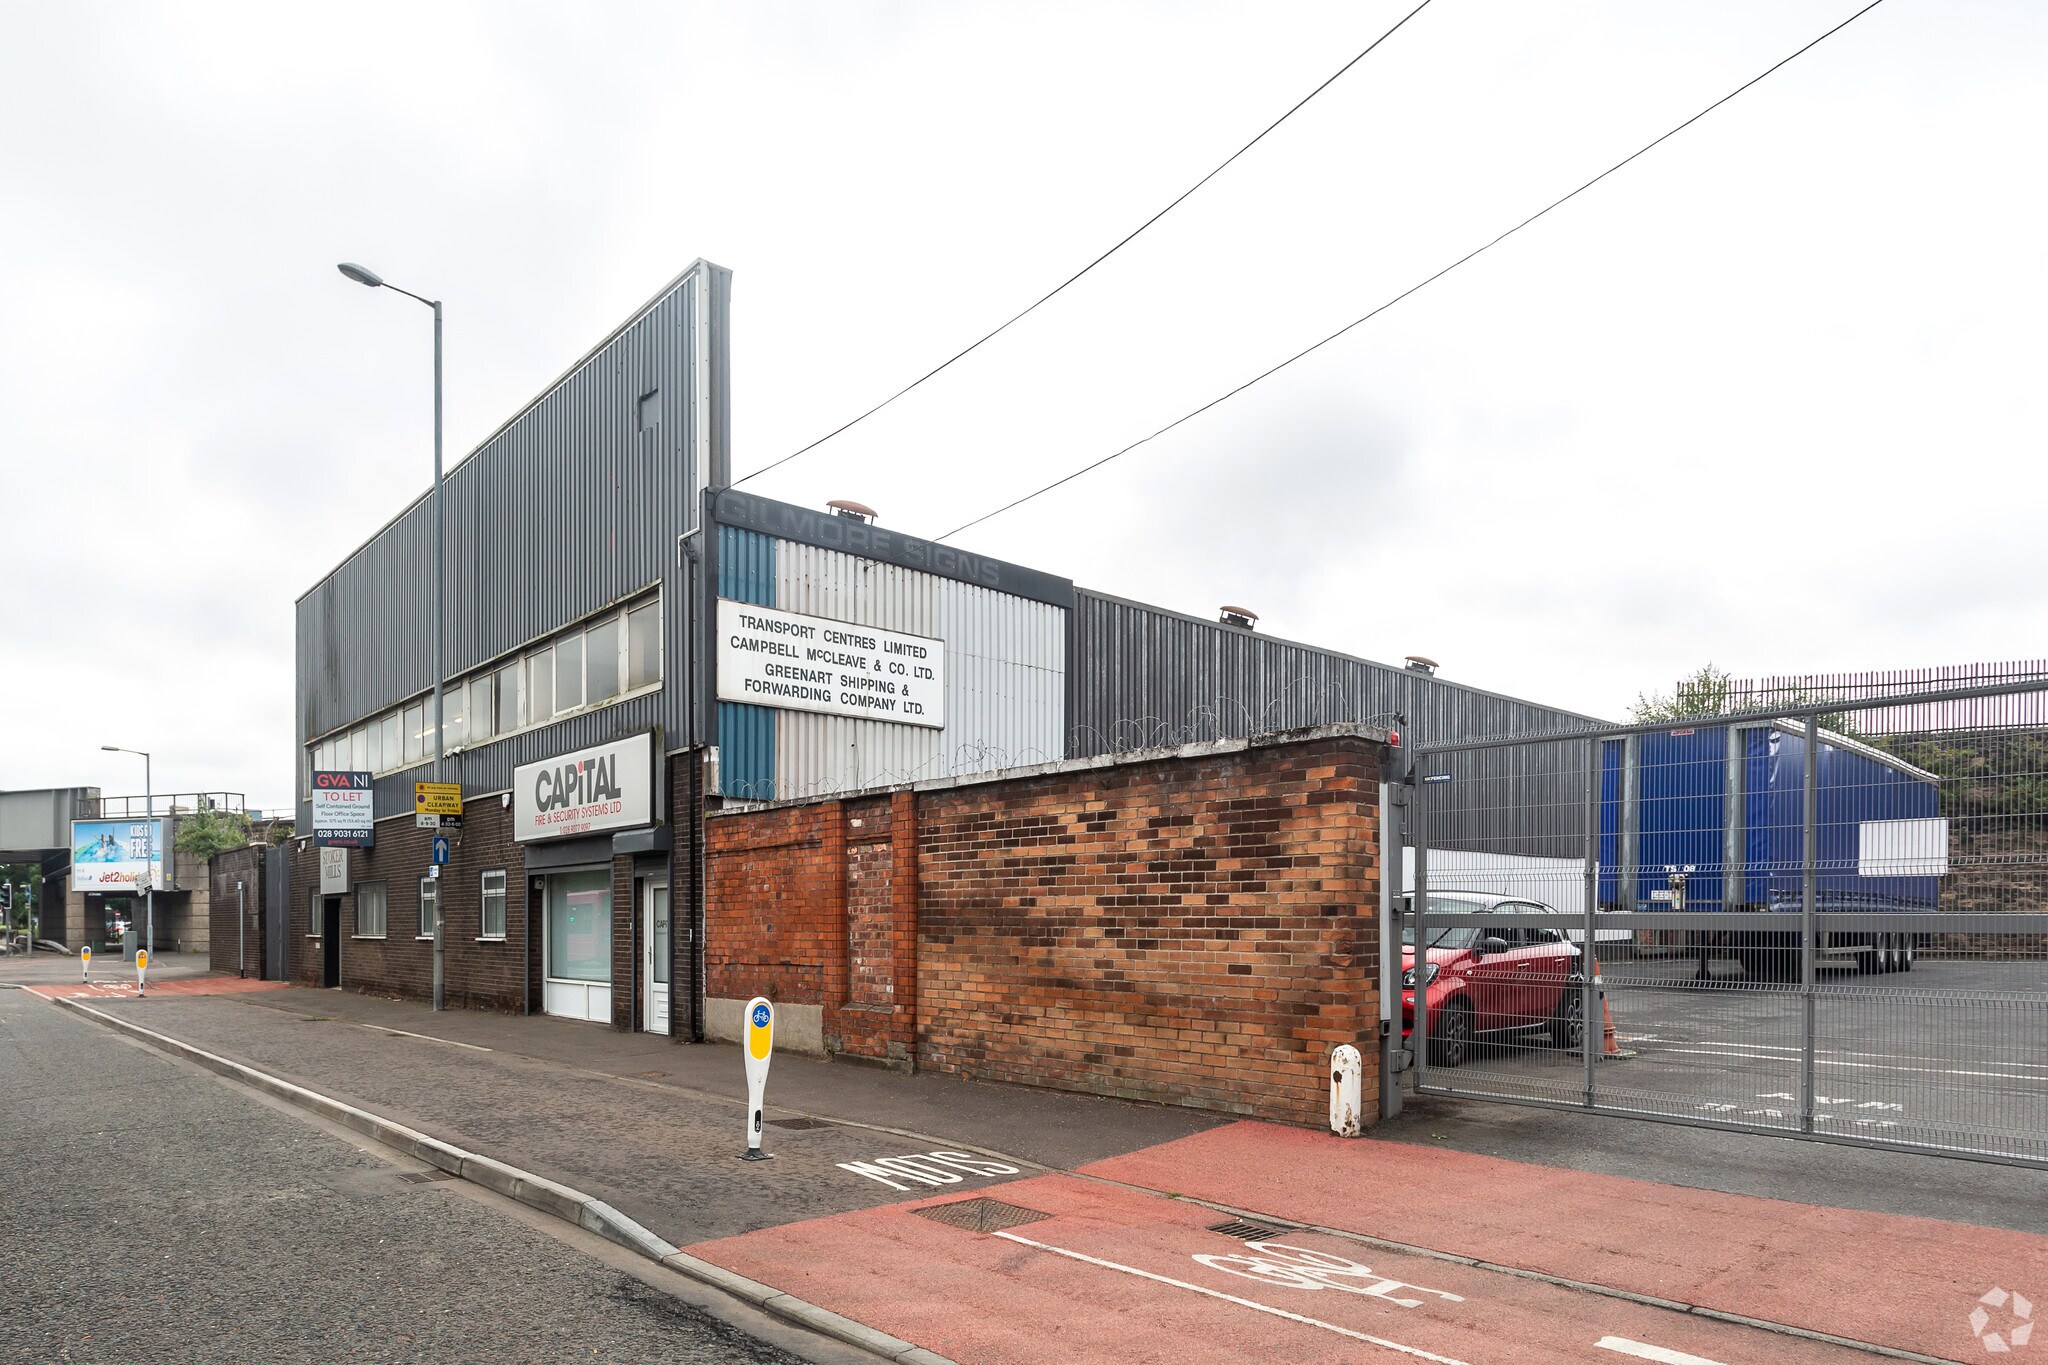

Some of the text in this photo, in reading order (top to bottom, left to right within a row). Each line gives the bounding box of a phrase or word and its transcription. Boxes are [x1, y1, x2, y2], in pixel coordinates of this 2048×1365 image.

[722, 494, 1000, 585] GILMORE SIGNS
[739, 614, 927, 659] TRANSPORT CENTRES LIMITED
[730, 635, 800, 659] CAMPBELL
[873, 659, 882, 672] &
[888, 662, 909, 677] CO.
[913, 666, 935, 681] LTD.
[744, 678, 925, 716] FORWARDING COMPANY LTD.
[765, 663, 910, 697] GREENART SHIPPING &
[317, 773, 369, 788] GVA NI
[323, 791, 363, 802] TO LET
[534, 800, 622, 827] FIRE & SECURITY SYSTEMS LTD
[130, 825, 144, 837] KIDS
[317, 829, 368, 838] 028 9031 6121
[835, 1151, 1020, 1191] SLOW
